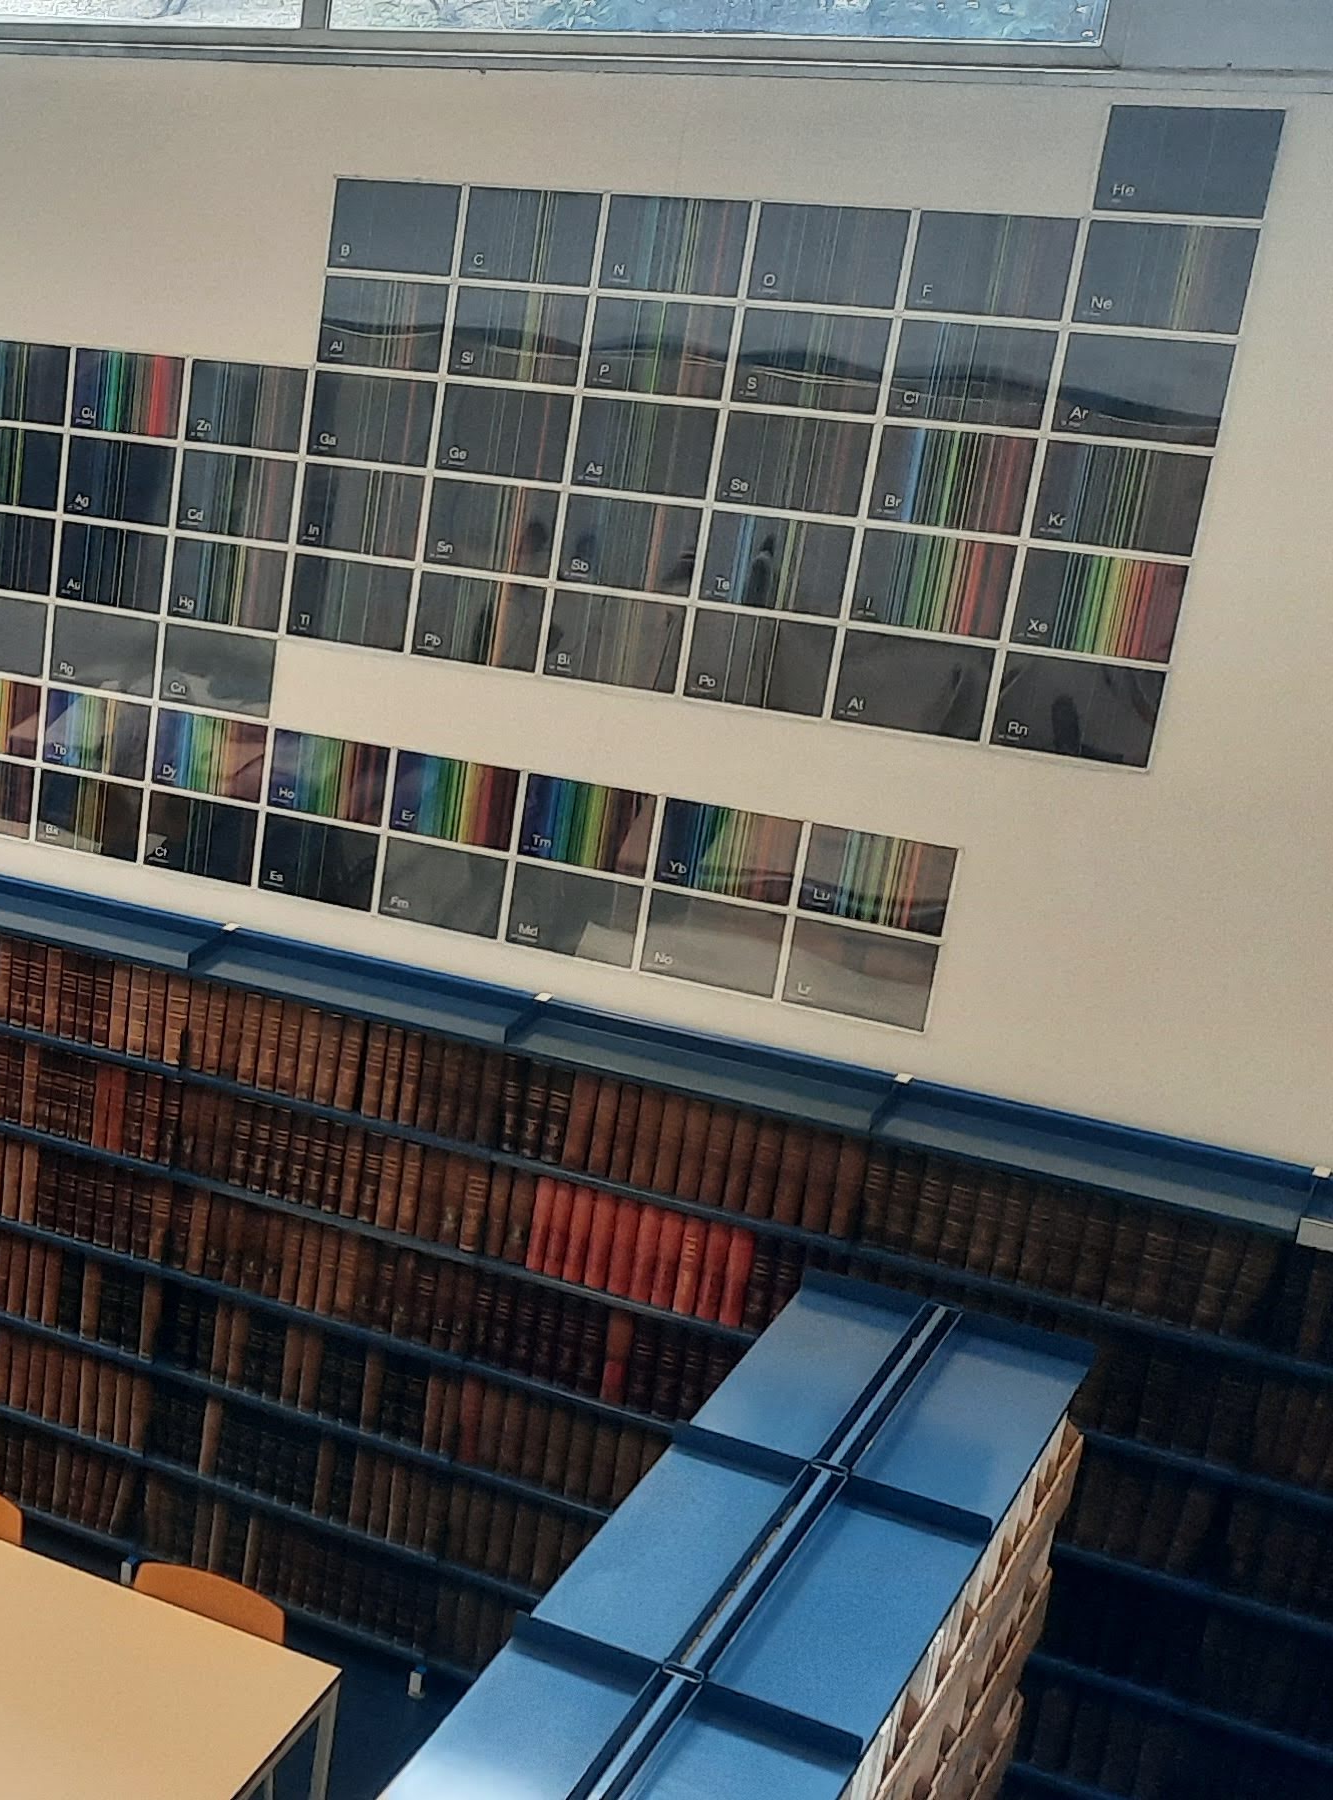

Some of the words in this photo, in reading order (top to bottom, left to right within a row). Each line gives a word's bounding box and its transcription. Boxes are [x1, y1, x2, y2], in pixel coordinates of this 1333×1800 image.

[1114, 184, 1134, 196] He
[340, 245, 350, 256] B
[474, 254, 484, 266] C
[614, 263, 625, 275] N
[764, 273, 776, 286] O
[922, 284, 933, 297] F
[1090, 296, 1113, 310] Ne
[461, 351, 473, 363] Si
[599, 364, 610, 376] P
[747, 377, 757, 389] S
[1069, 407, 1088, 420] Ar
[197, 419, 211, 432] Zn
[320, 433, 336, 446] Ga
[586, 463, 603, 476] As
[75, 494, 89, 508] Ag
[884, 494, 901, 508] Br
[187, 508, 204, 522] Cd
[1048, 513, 1066, 526] Kr
[309, 524, 319, 536] In
[437, 541, 453, 554] Sn
[571, 558, 589, 573] Sb
[68, 578, 81, 591] Au
[716, 577, 729, 591] Te
[179, 596, 194, 611] Hg
[866, 597, 870, 609] I
[1028, 619, 1047, 633] Xe
[424, 634, 441, 646] Pb
[557, 653, 571, 666] Bi
[170, 681, 185, 693] Cn
[699, 674, 716, 689] Po
[848, 697, 863, 710] At
[1008, 722, 1028, 736] Rn
[53, 743, 67, 755] Tb
[162, 764, 177, 778] Dy
[279, 788, 295, 799] Ho
[402, 810, 414, 821] Er
[533, 835, 551, 847] Tm
[669, 861, 687, 875] Yb
[270, 871, 283, 882] Es
[814, 888, 830, 900] Lu
[518, 922, 538, 935] Md
[655, 951, 673, 964] No
